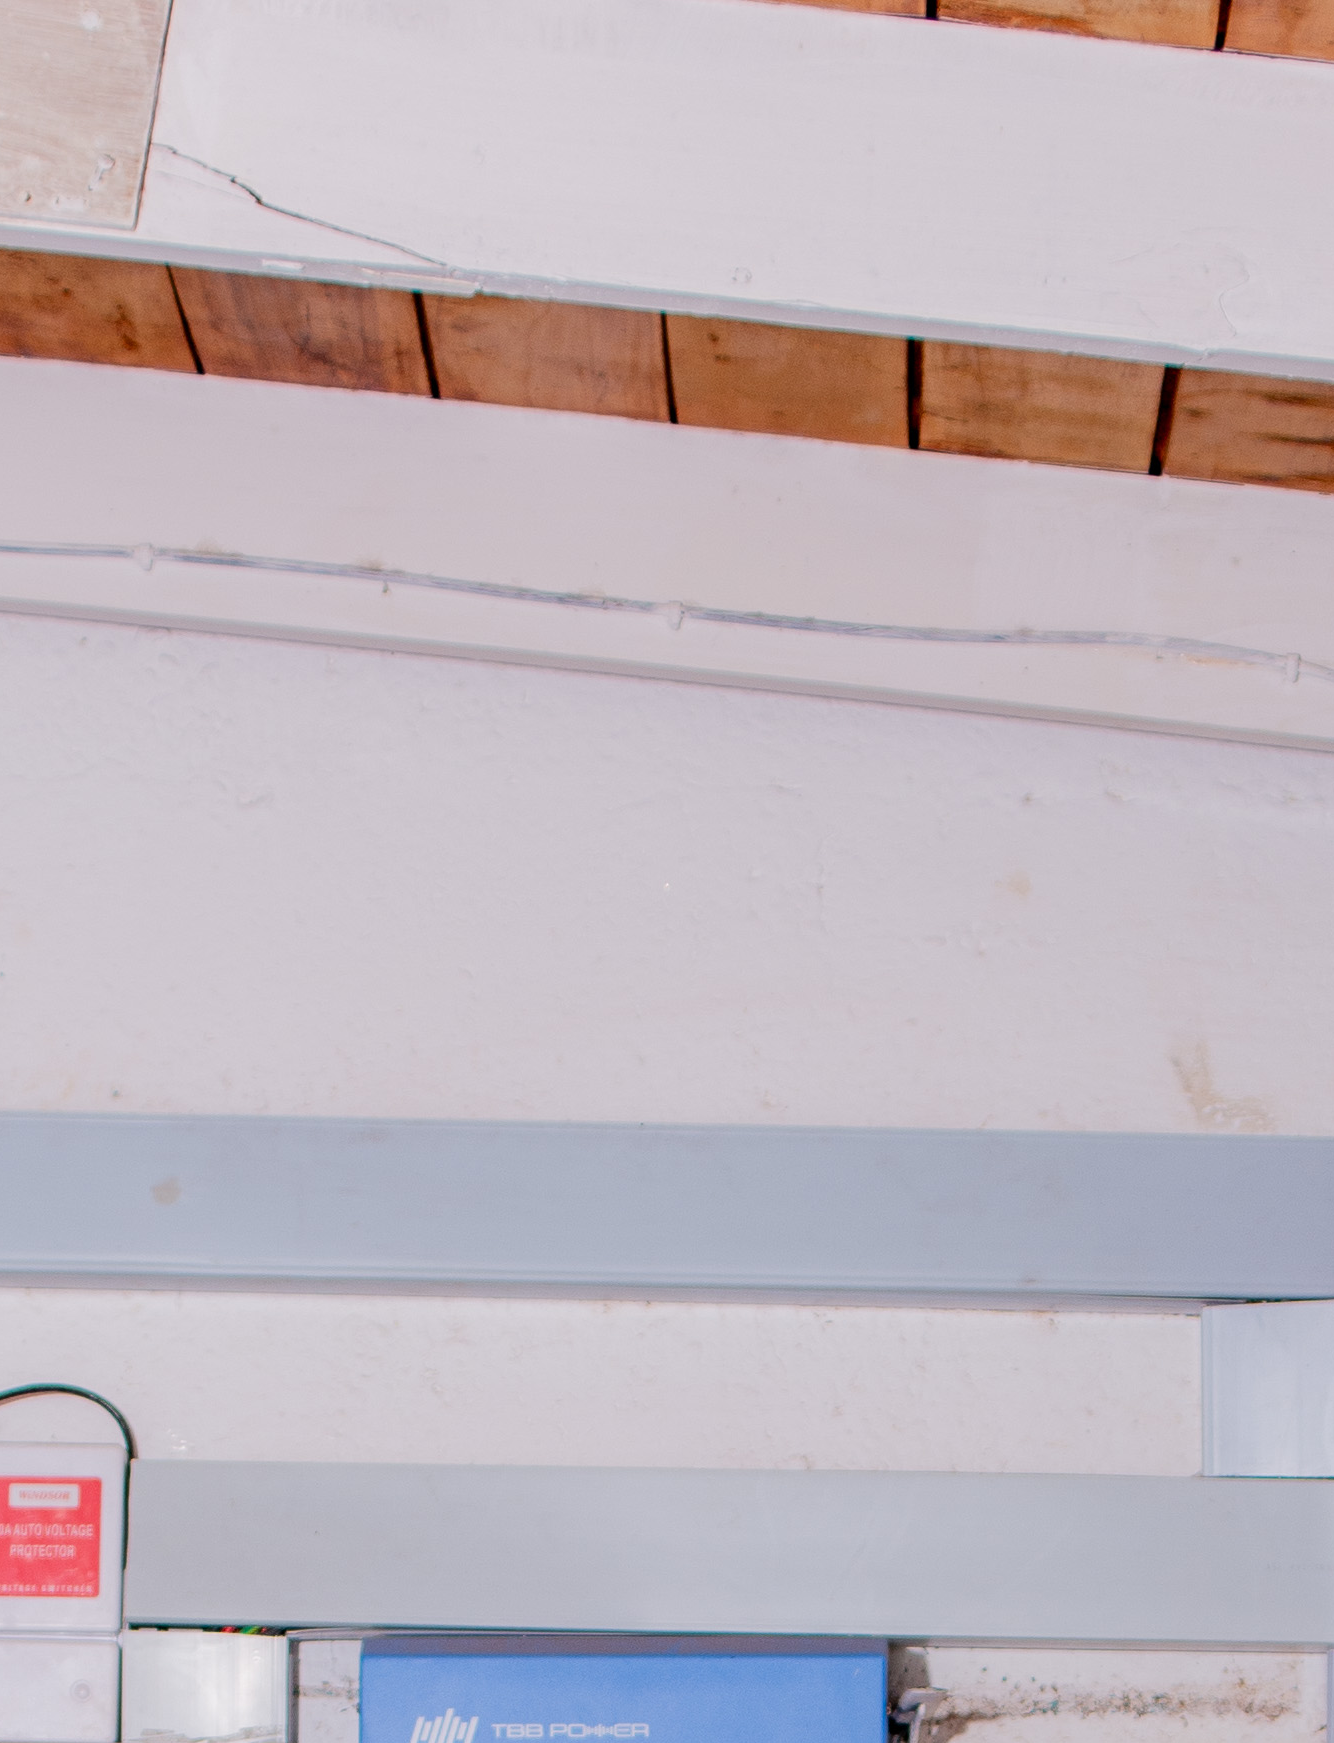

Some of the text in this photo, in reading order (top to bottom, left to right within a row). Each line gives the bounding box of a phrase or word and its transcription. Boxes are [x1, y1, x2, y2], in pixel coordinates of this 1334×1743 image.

[12, 1524, 42, 1536] AUTO
[45, 1524, 94, 1537] VOLTAGE
[10, 1544, 76, 1558] PROTECTOR
[491, 1723, 543, 1737] TBB
